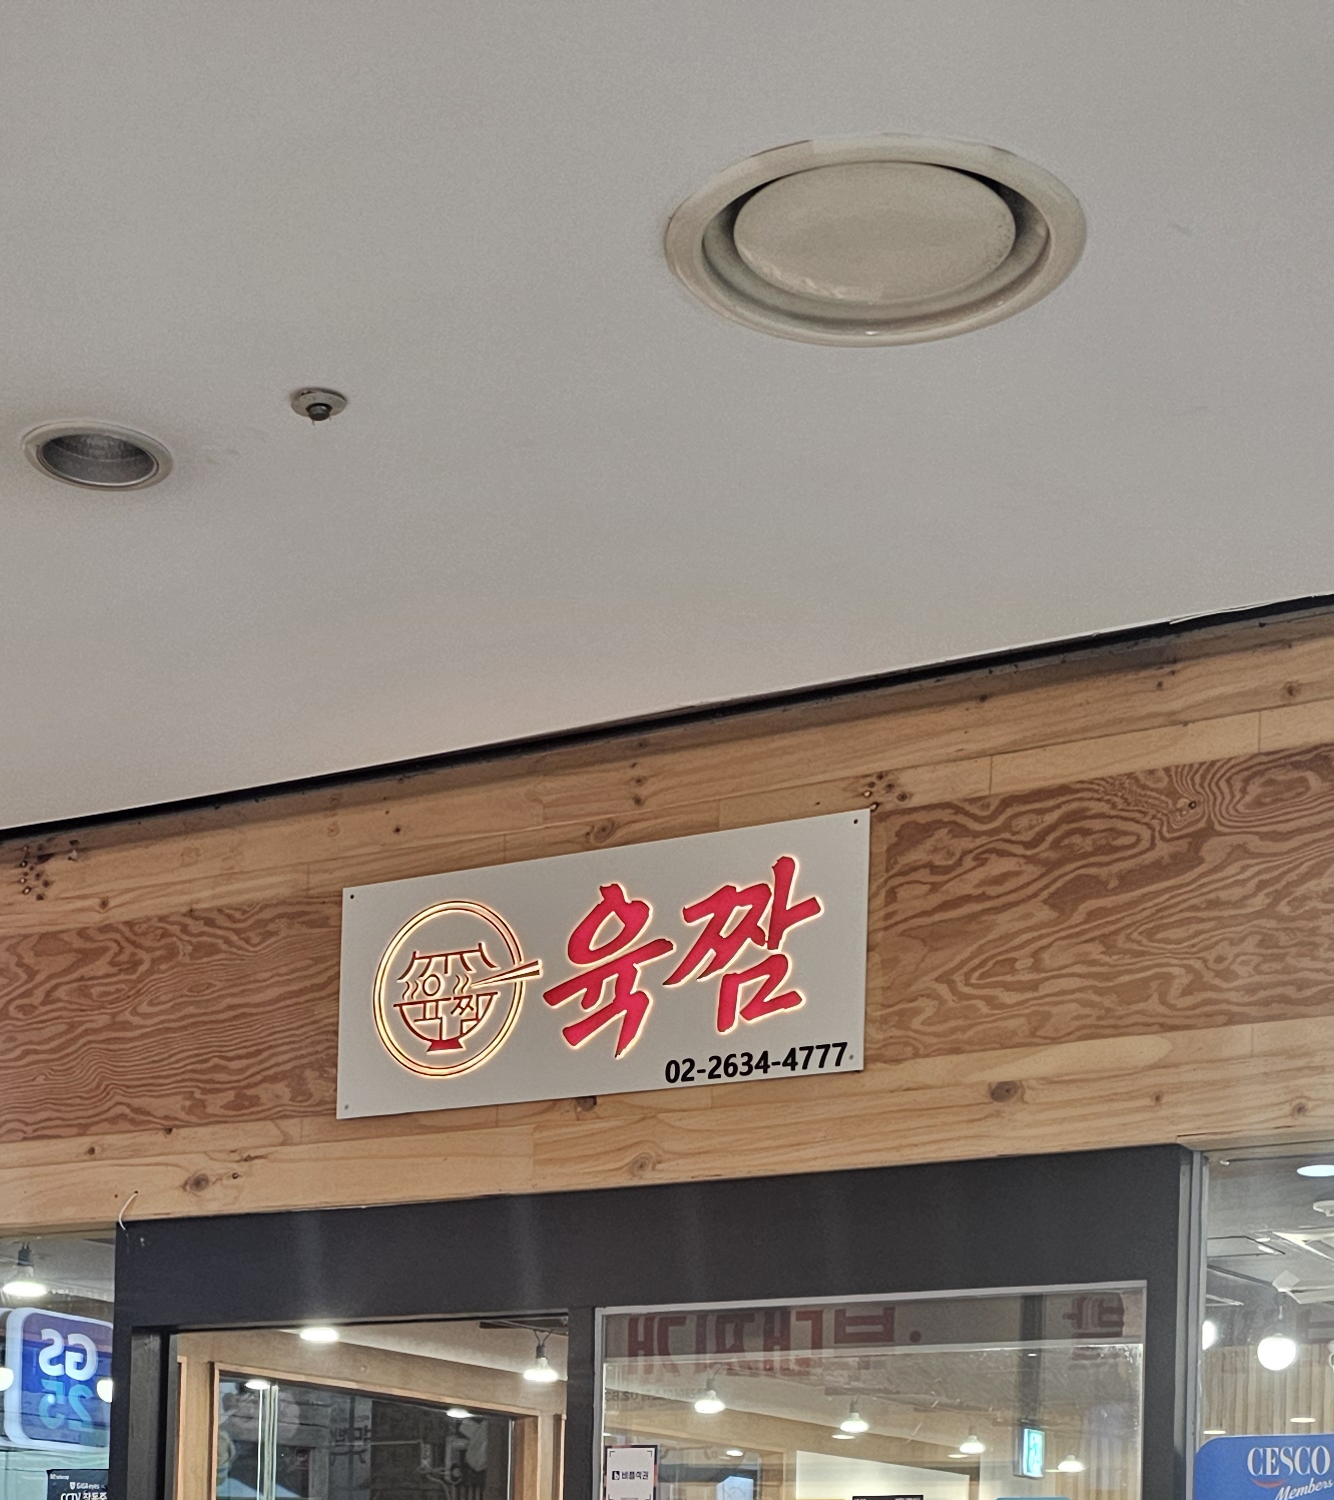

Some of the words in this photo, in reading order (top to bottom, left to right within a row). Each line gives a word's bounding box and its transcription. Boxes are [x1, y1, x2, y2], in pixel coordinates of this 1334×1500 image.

[543, 855, 824, 1059] 육짬
[665, 1042, 848, 1084] 02-2634-4777
[1246, 1445, 1330, 1476] CESCO
